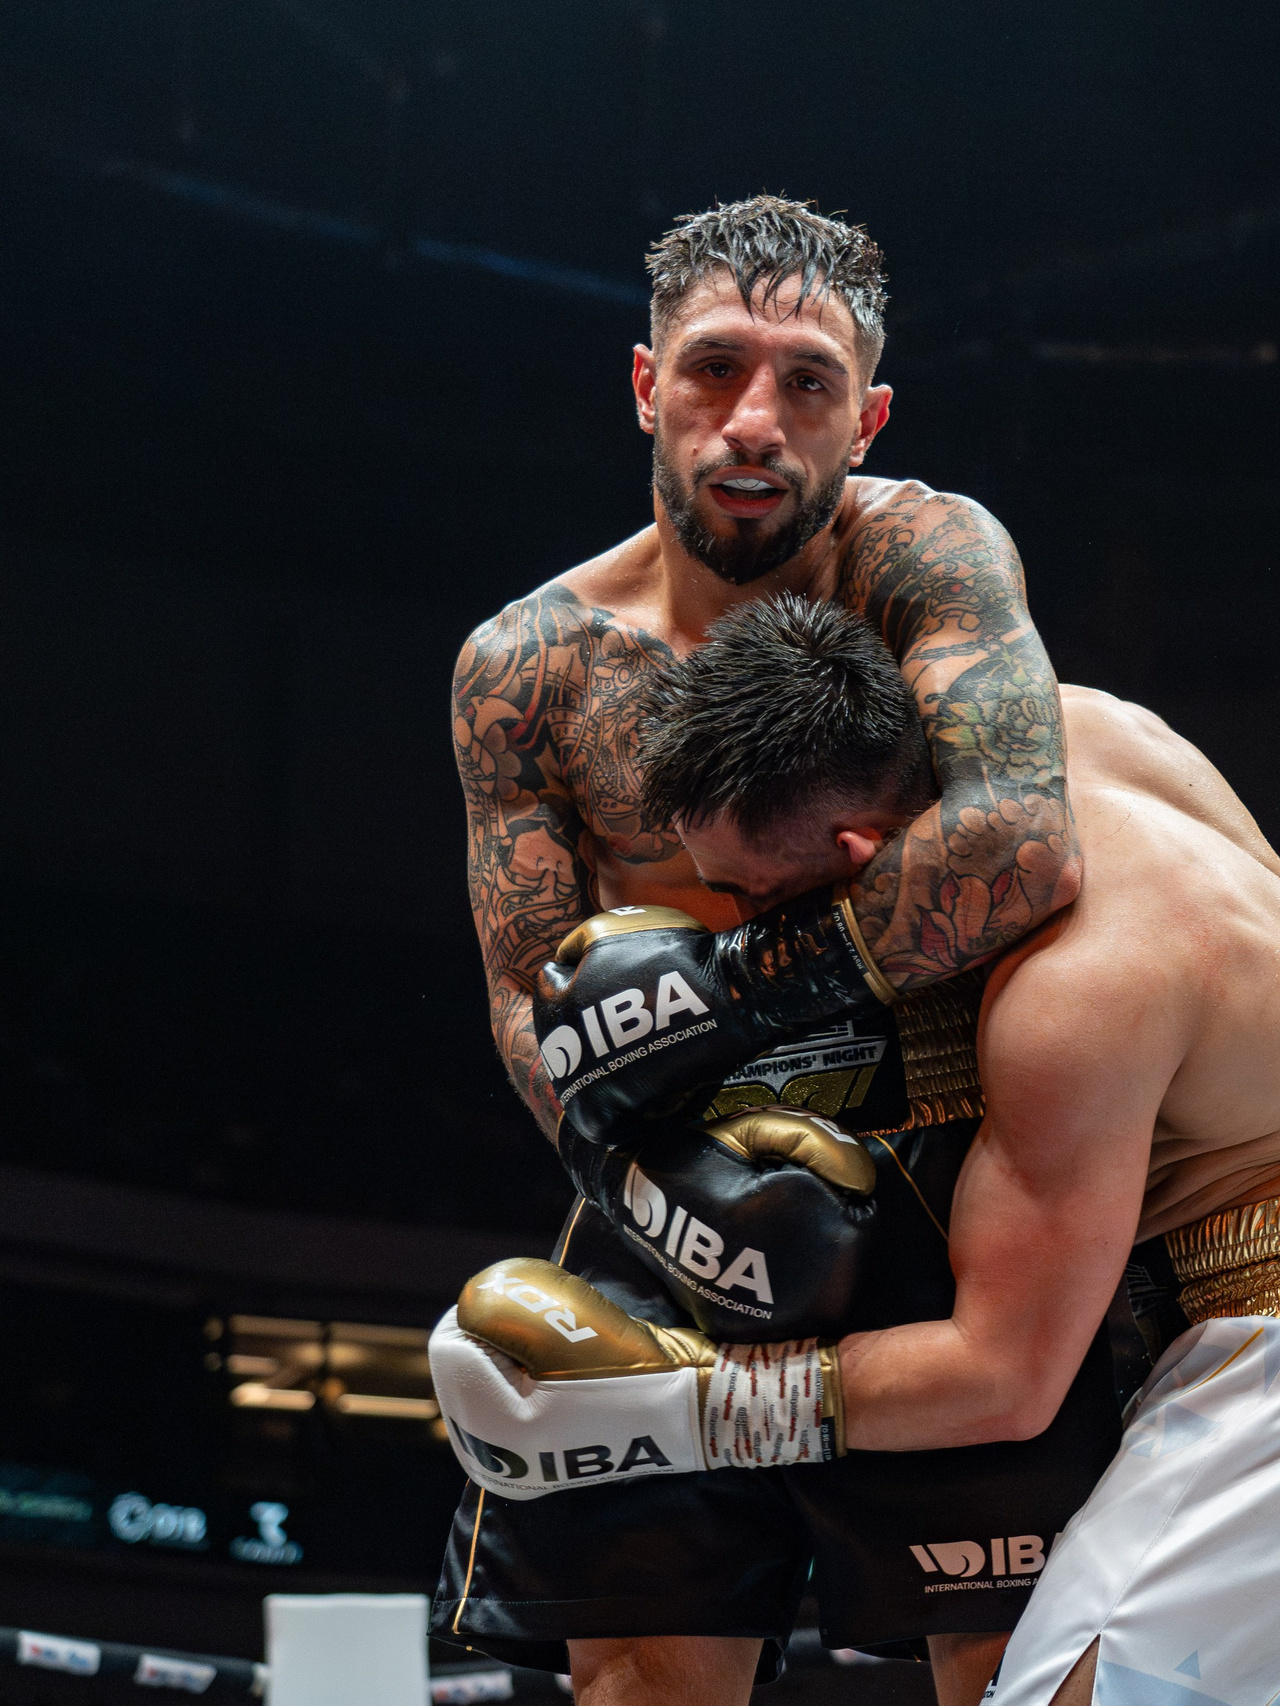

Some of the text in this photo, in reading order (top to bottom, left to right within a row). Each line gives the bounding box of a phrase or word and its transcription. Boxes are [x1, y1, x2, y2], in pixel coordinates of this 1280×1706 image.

[582, 970, 710, 1058] IBA
[560, 1019, 718, 1108] TERNATIONAL BOXING ASSOCIATION
[725, 1046, 877, 1082] HAMPIONS' NIGHT
[665, 1205, 774, 1304] IBA
[476, 1271, 599, 1344] RDX
[667, 1262, 698, 1291] BOXING
[697, 1285, 773, 1320] ASSOCIATION
[538, 1434, 673, 1482] IBA
[991, 1533, 1062, 1577] IB
[924, 1580, 994, 1594] INTERNATIONAL
[996, 1578, 1032, 1589] BOXING
